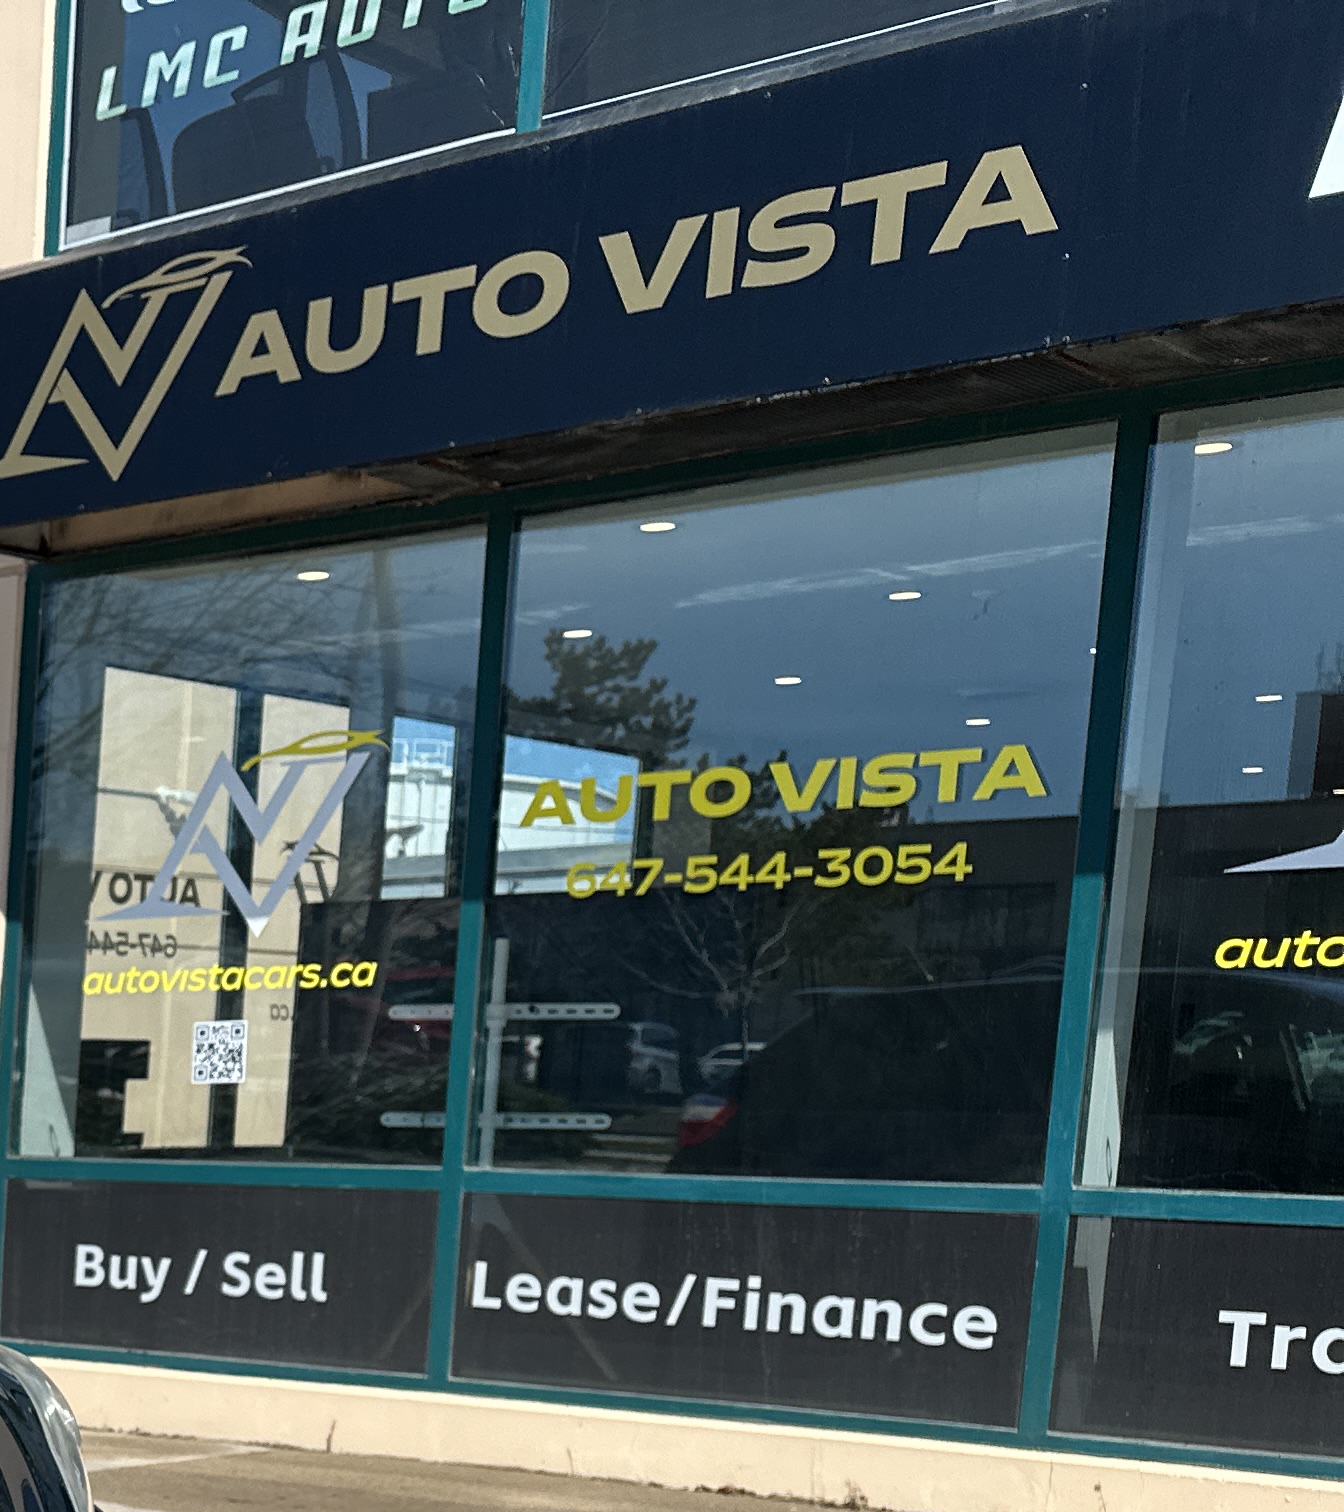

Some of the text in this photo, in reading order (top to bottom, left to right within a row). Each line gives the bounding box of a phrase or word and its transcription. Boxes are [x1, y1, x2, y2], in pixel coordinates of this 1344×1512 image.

[95, 0, 488, 122] LMC AU
[214, 144, 1059, 398] AUTO VISTA
[519, 744, 1048, 828] AUTO VISTA
[565, 841, 973, 899] 647-544-3054
[83, 960, 378, 996] autovistacars.ca
[74, 1243, 172, 1304] Buy
[221, 1250, 328, 1303] Sell
[472, 1260, 998, 1351] Lease/Finance
